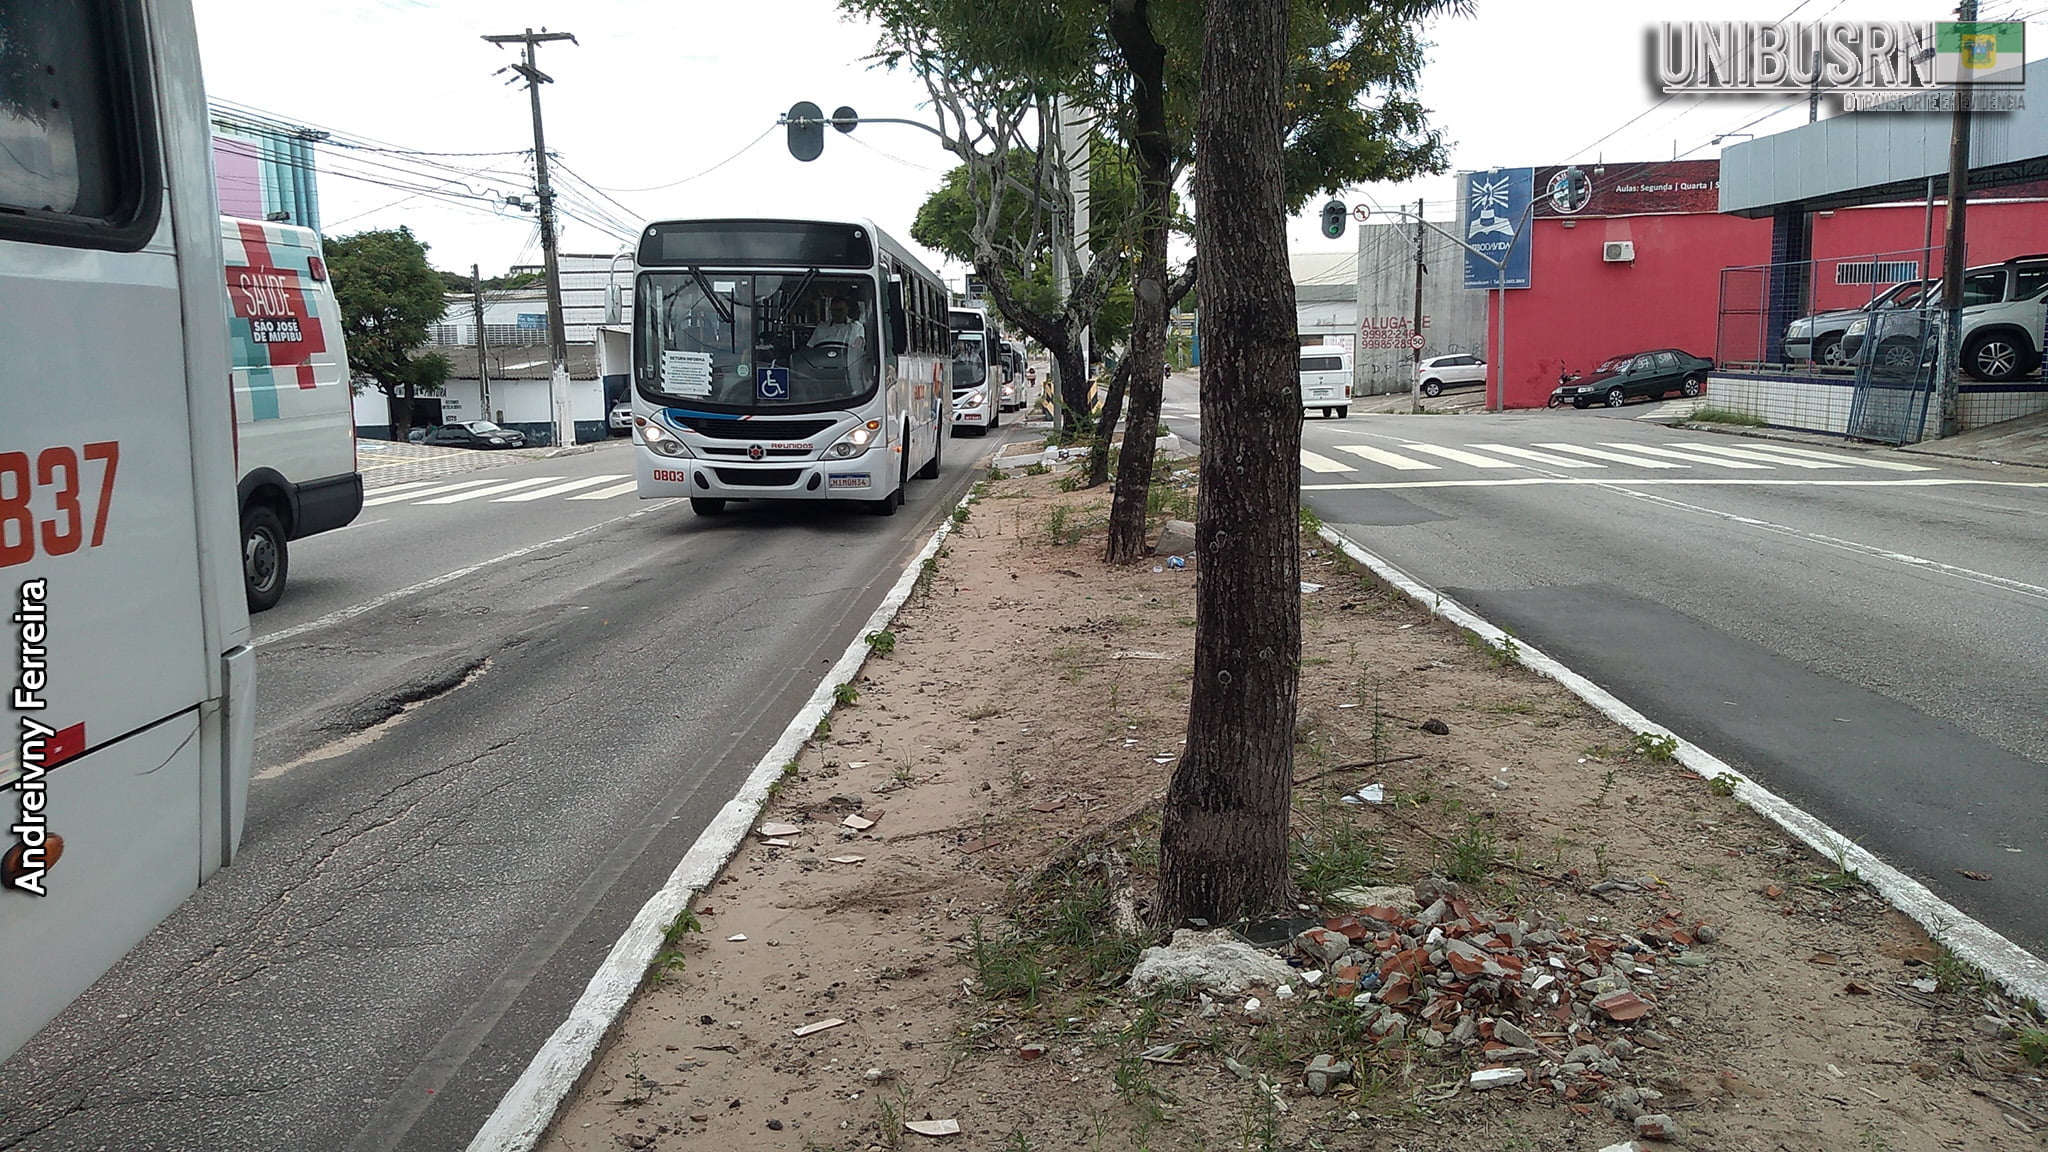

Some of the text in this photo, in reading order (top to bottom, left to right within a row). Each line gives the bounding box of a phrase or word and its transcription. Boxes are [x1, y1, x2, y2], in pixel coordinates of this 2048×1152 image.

[1615, 184, 1639, 193] Aulas:
[1640, 184, 1673, 193] Segunda
[1680, 182, 1707, 191] Quarta
[240, 264, 295, 316] SAÚDE
[254, 318, 299, 332] SÃO JOSÉ
[1361, 315, 1431, 330] ALUGA-E
[253, 331, 303, 342] DE MIPIBU
[1412, 337, 1424, 346] 50
[653, 469, 685, 483] 0803
